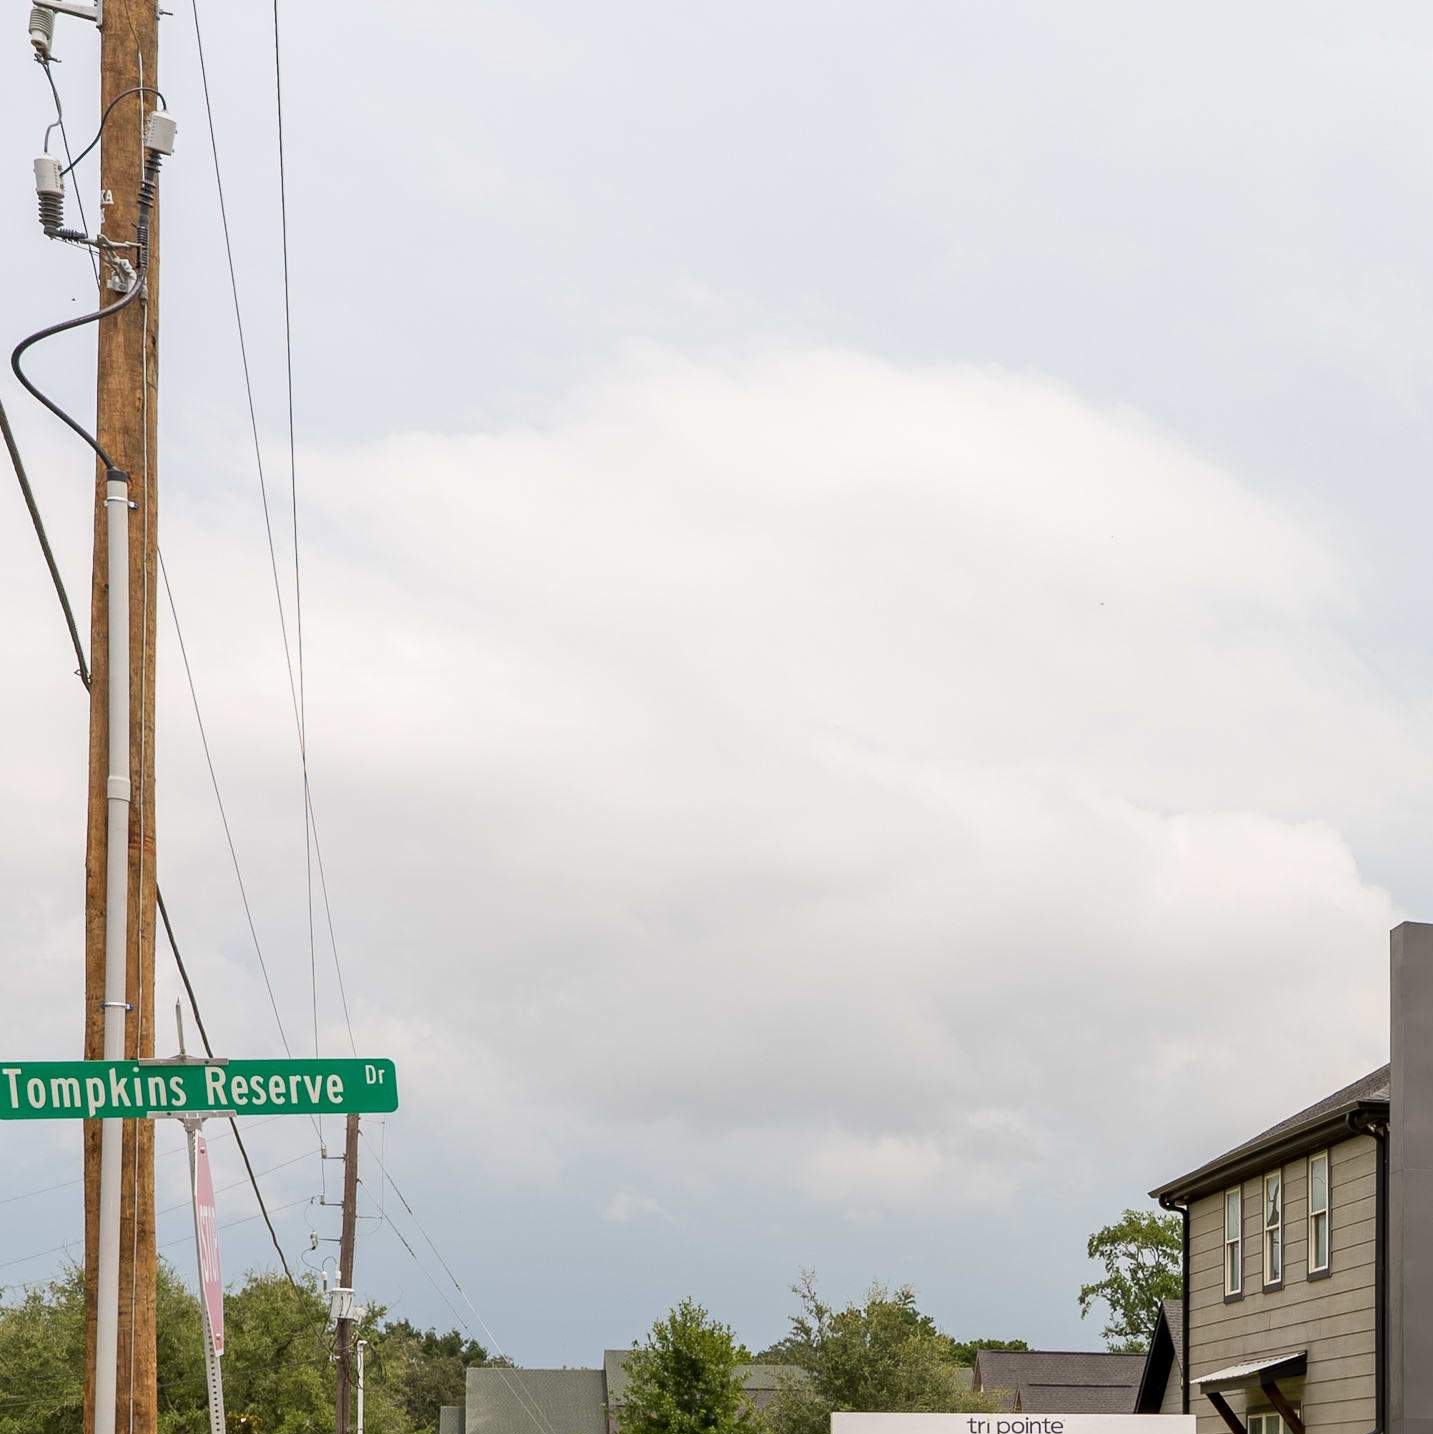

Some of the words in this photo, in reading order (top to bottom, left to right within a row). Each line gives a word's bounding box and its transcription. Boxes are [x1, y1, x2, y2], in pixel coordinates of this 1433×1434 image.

[2, 1066, 187, 1118] Tompkins
[204, 1066, 344, 1105] Reserve
[365, 1064, 385, 1084] Dr
[966, 1417, 991, 1434] tri
